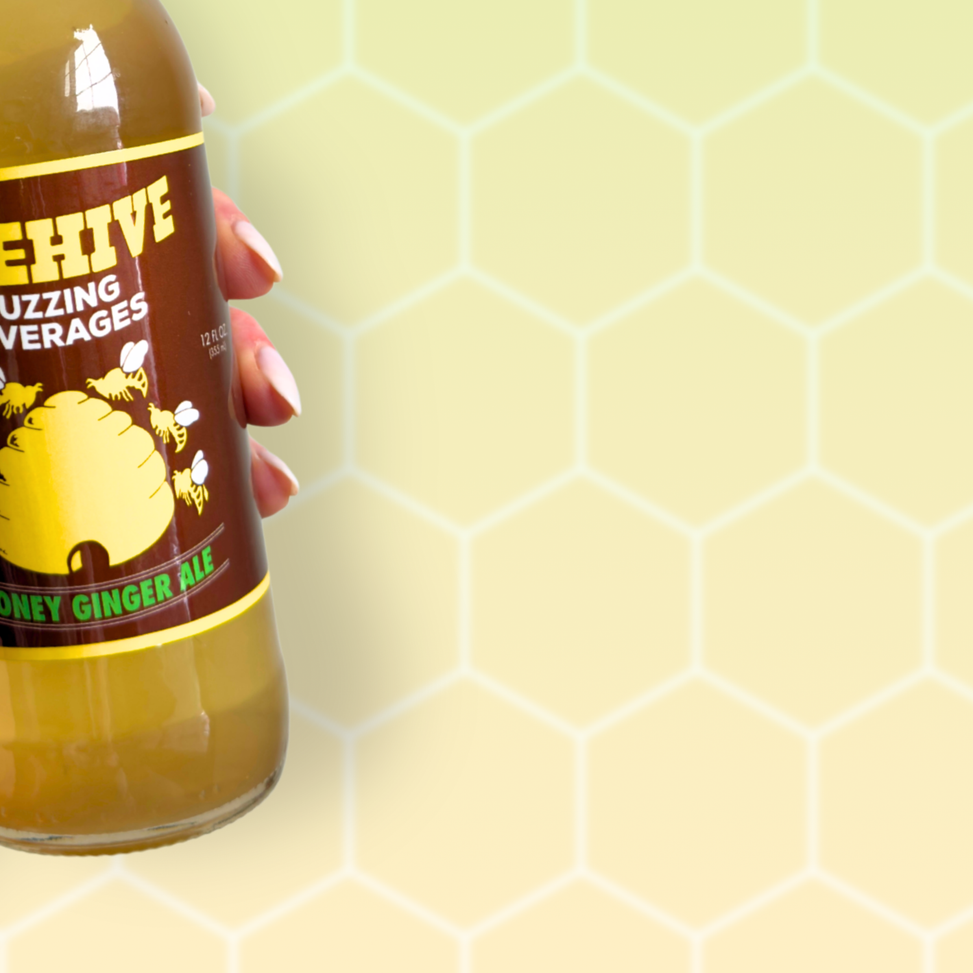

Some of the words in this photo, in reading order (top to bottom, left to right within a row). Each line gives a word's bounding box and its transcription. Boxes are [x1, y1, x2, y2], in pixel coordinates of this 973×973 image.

[200, 331, 211, 347] 12
[71, 573, 174, 622] GINGER
[179, 545, 215, 593] ALE
